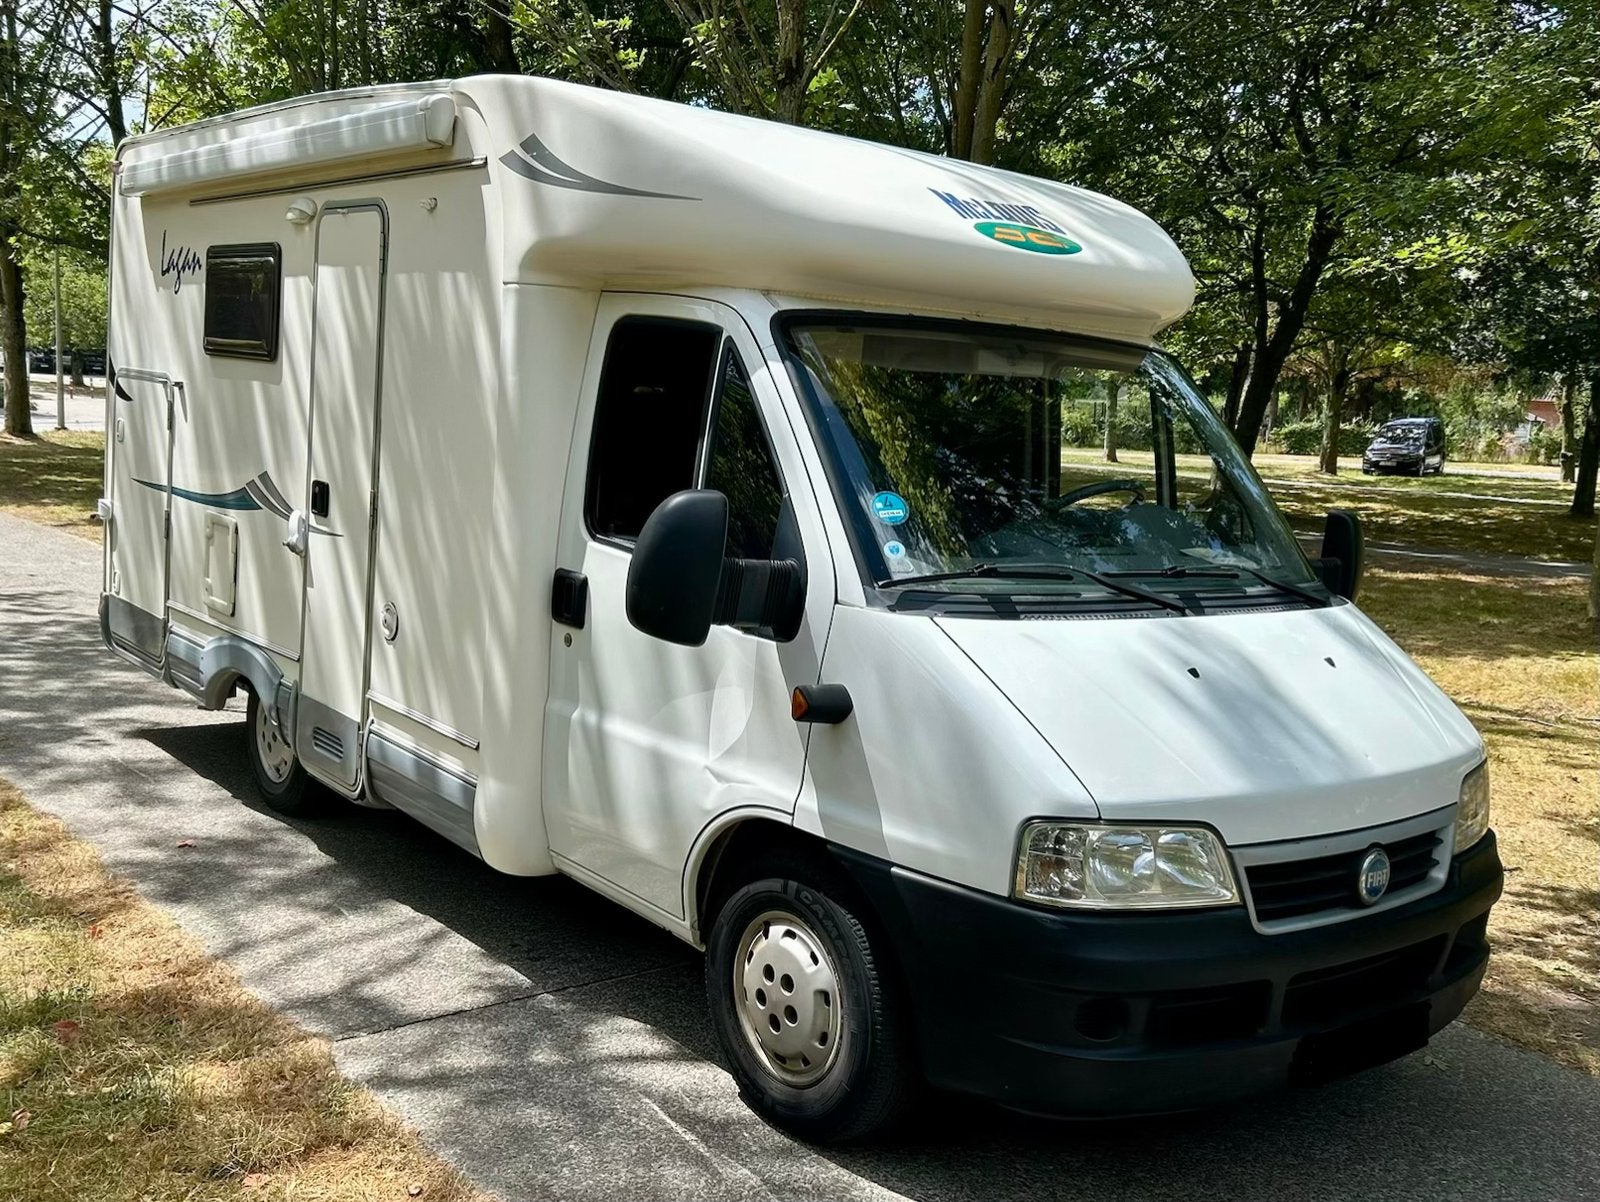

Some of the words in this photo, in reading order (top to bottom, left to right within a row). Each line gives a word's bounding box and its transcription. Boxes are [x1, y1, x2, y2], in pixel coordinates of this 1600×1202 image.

[161, 229, 202, 295] Lagan
[883, 495, 894, 509] 4
[1367, 868, 1389, 888] FIAT
